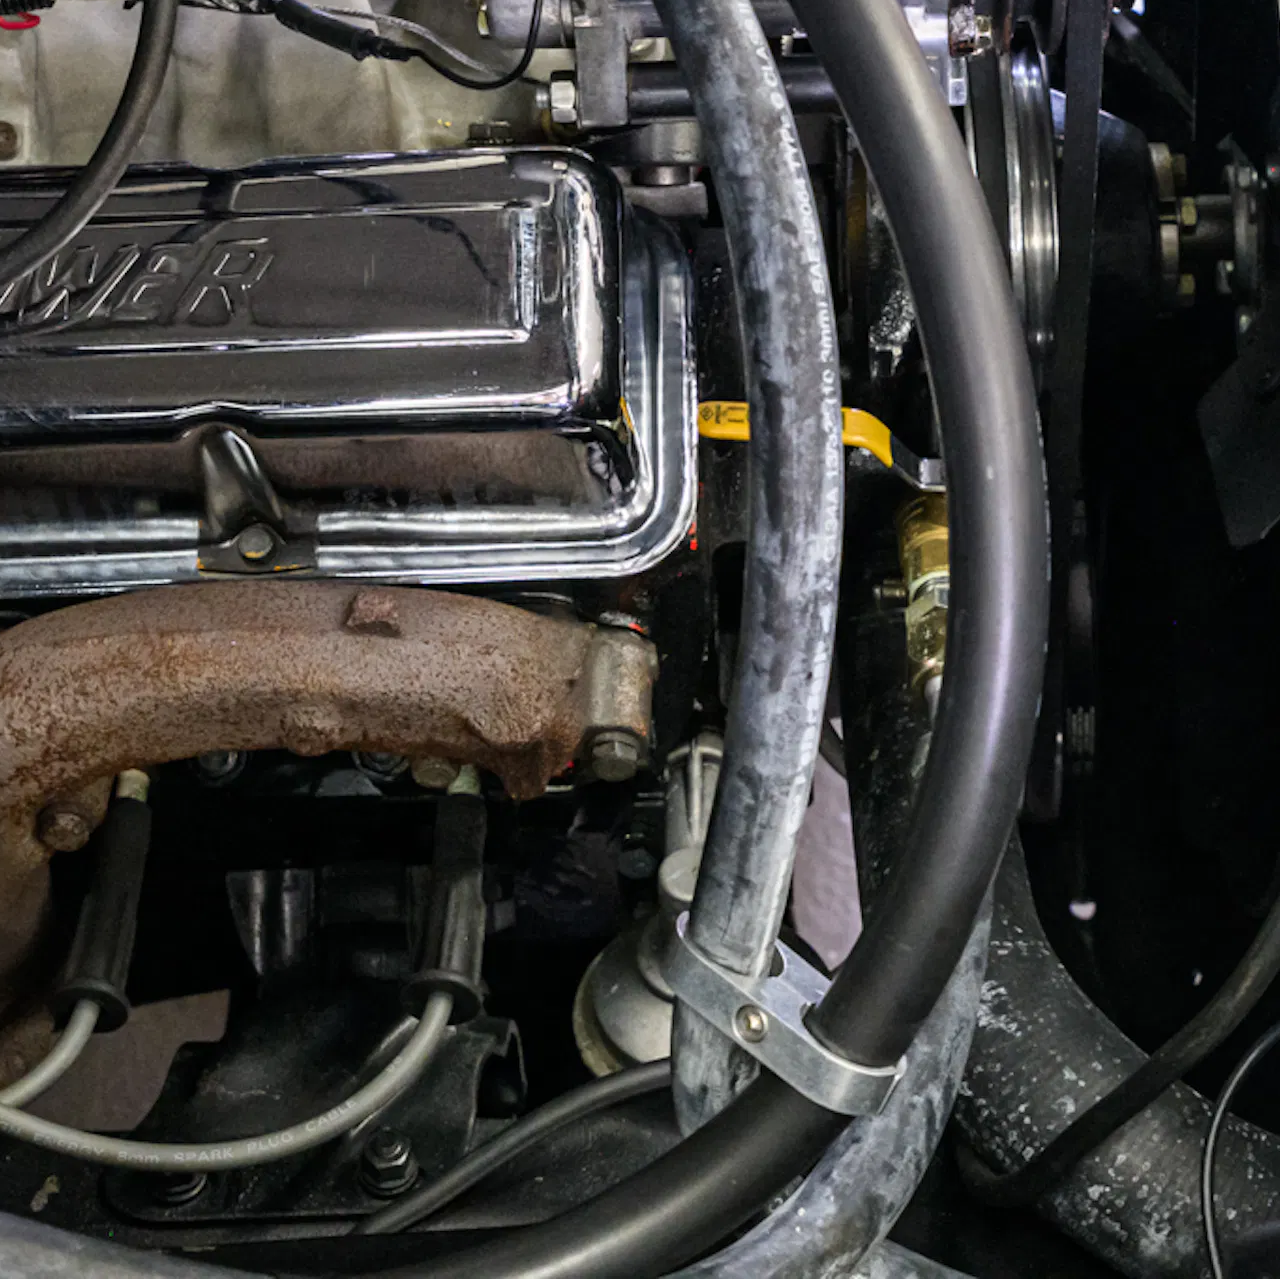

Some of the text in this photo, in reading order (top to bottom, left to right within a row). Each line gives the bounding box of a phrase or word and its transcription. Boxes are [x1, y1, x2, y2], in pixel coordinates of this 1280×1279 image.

[807, 247, 825, 295] SAE
[117, 1150, 160, 1165] 8mm
[173, 1146, 235, 1163] SPARK
[246, 1132, 295, 1154] PLUG
[304, 1098, 358, 1133] CABLE
